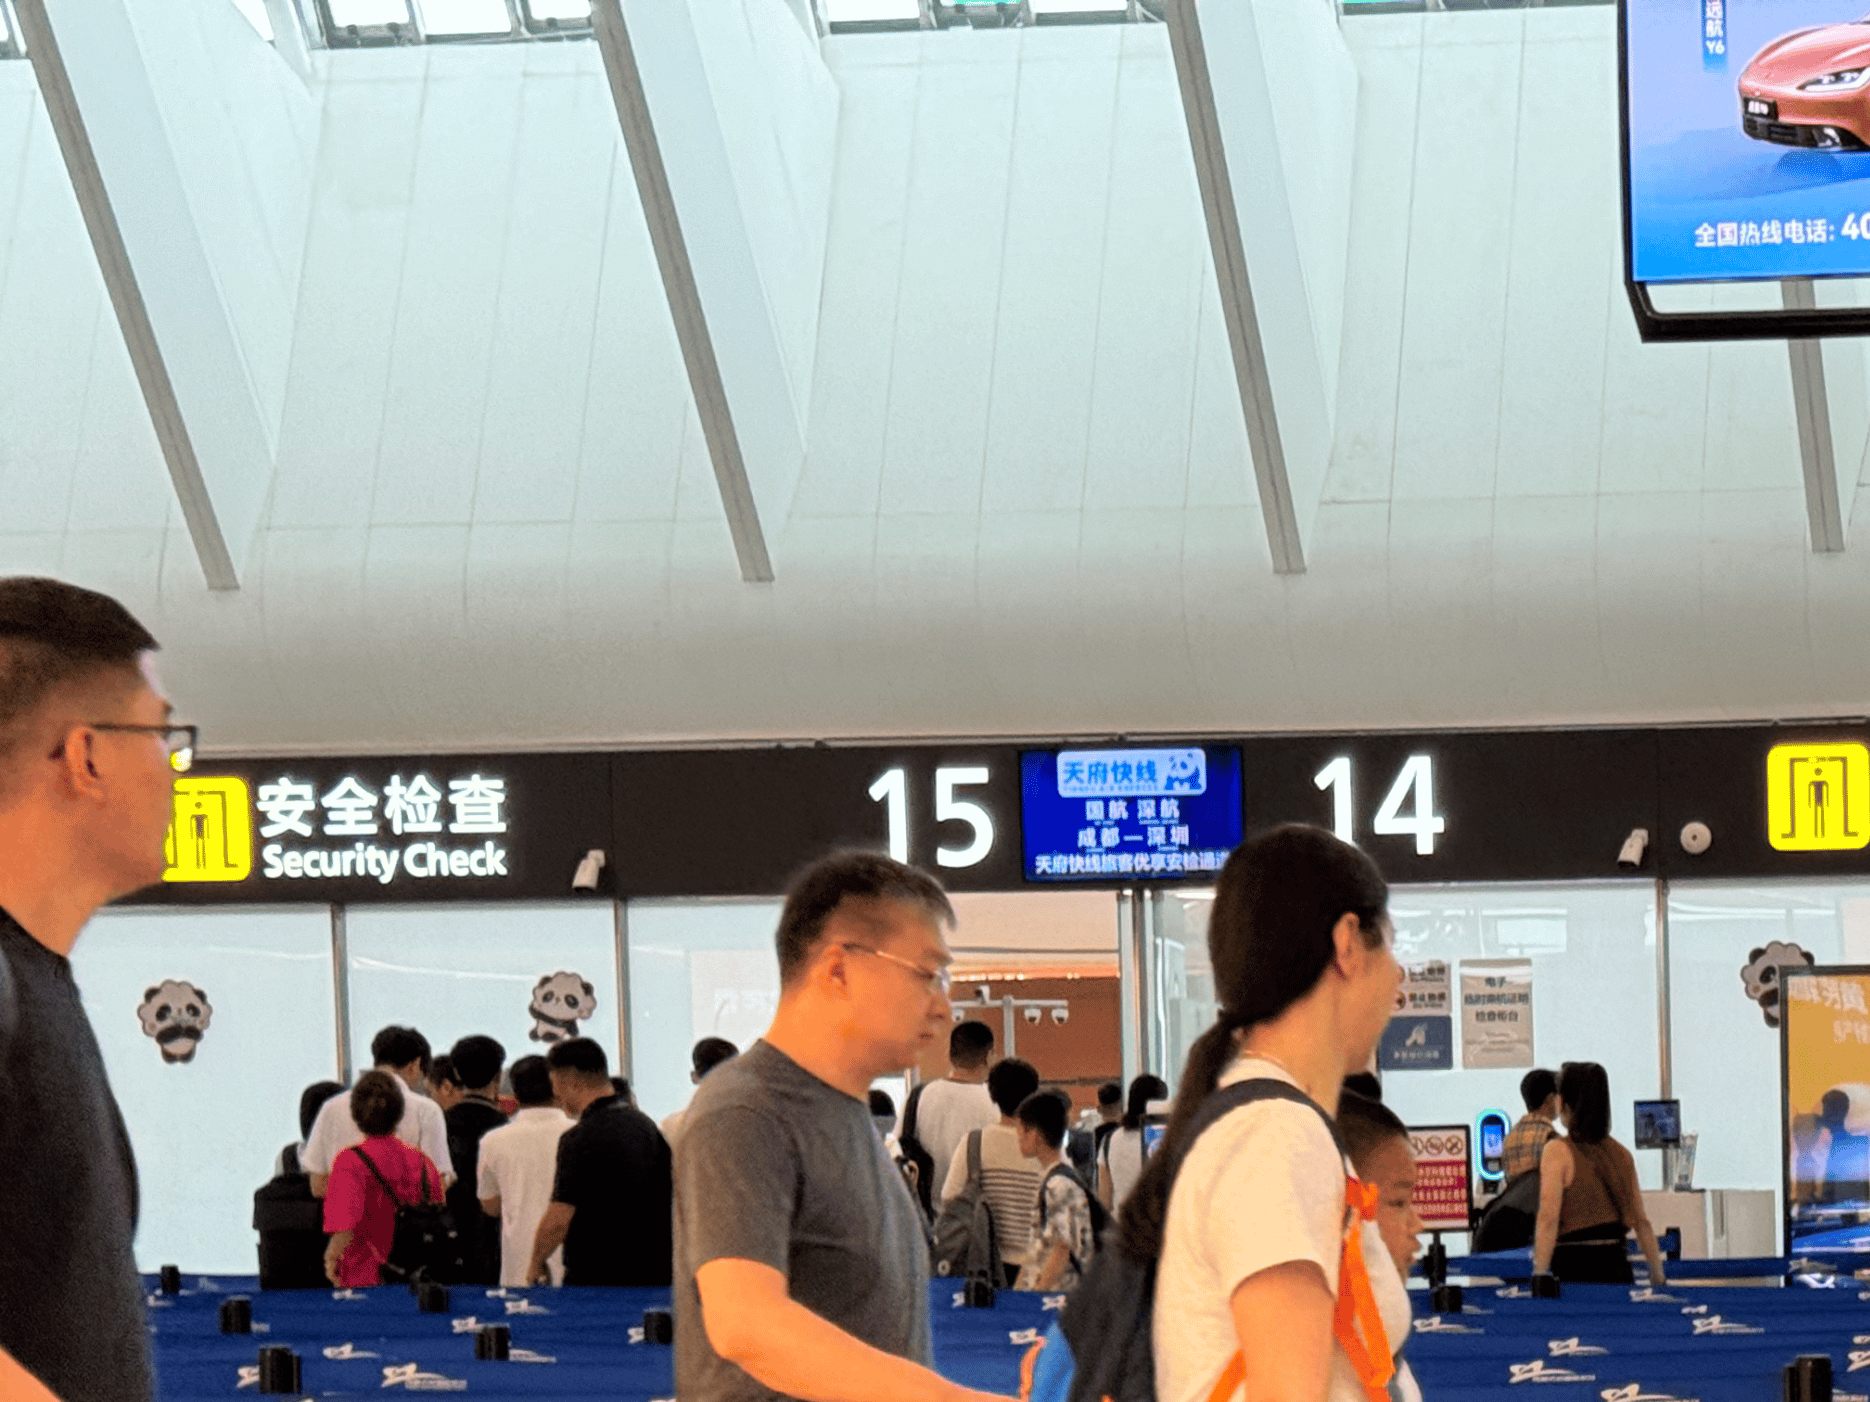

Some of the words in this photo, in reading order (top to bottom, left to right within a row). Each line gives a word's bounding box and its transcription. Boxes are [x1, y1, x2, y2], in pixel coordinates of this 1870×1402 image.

[1063, 760, 1157, 784] 天府快线
[257, 774, 507, 837] 安全检查
[868, 766, 995, 868] 15
[1314, 755, 1445, 856] 14
[262, 842, 399, 884] Security
[404, 842, 508, 878] Check
